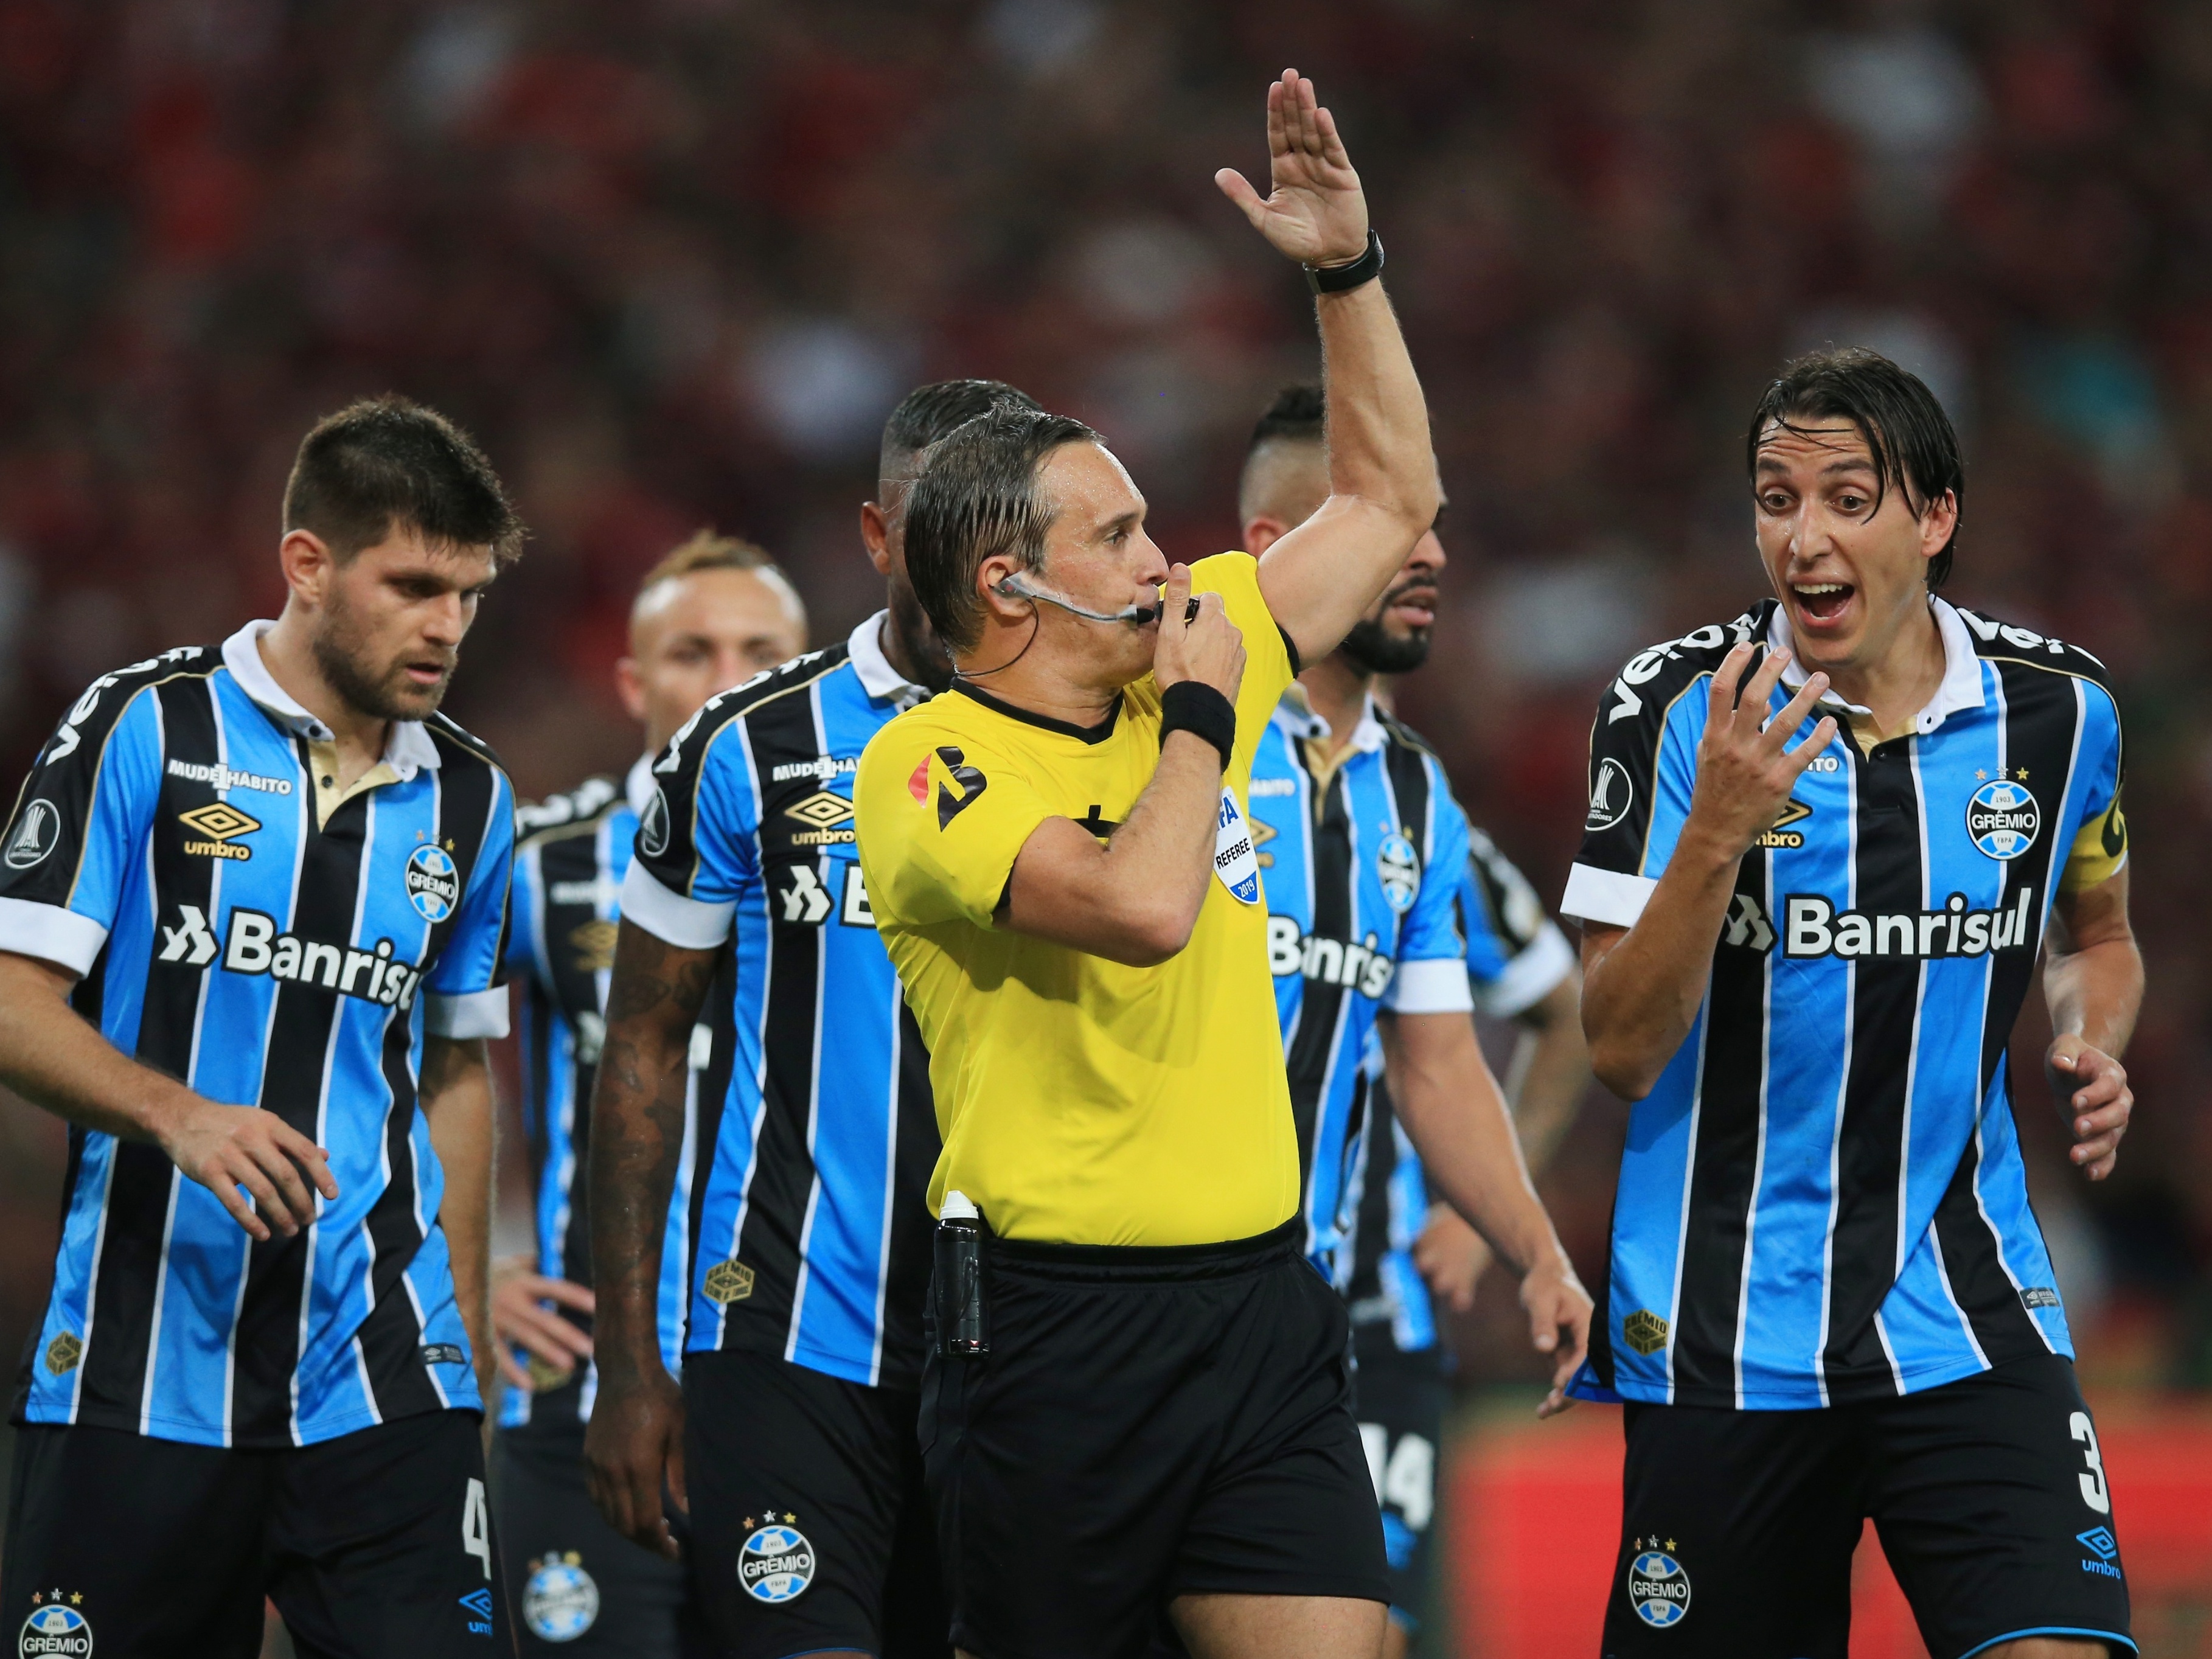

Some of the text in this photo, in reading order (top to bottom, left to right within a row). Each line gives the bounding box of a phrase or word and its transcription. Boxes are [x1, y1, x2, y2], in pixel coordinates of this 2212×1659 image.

[1971, 810, 2036, 829] GRÊMIO
[791, 828, 855, 846] umbro
[184, 839, 251, 860] umbro
[1216, 837, 1251, 869] REFEREE
[409, 871, 456, 900] GRÊMIO
[1237, 879, 1255, 898] 2019
[1787, 887, 2032, 956] Banrisul
[2070, 1411, 2109, 1514] 3
[462, 1478, 492, 1581] 4
[743, 1554, 810, 1578] GRÊMIO
[2081, 1559, 2121, 1580] umbro
[1633, 1578, 1687, 1599] GRÊMIO
[23, 1633, 88, 1654] GRÊMIO
